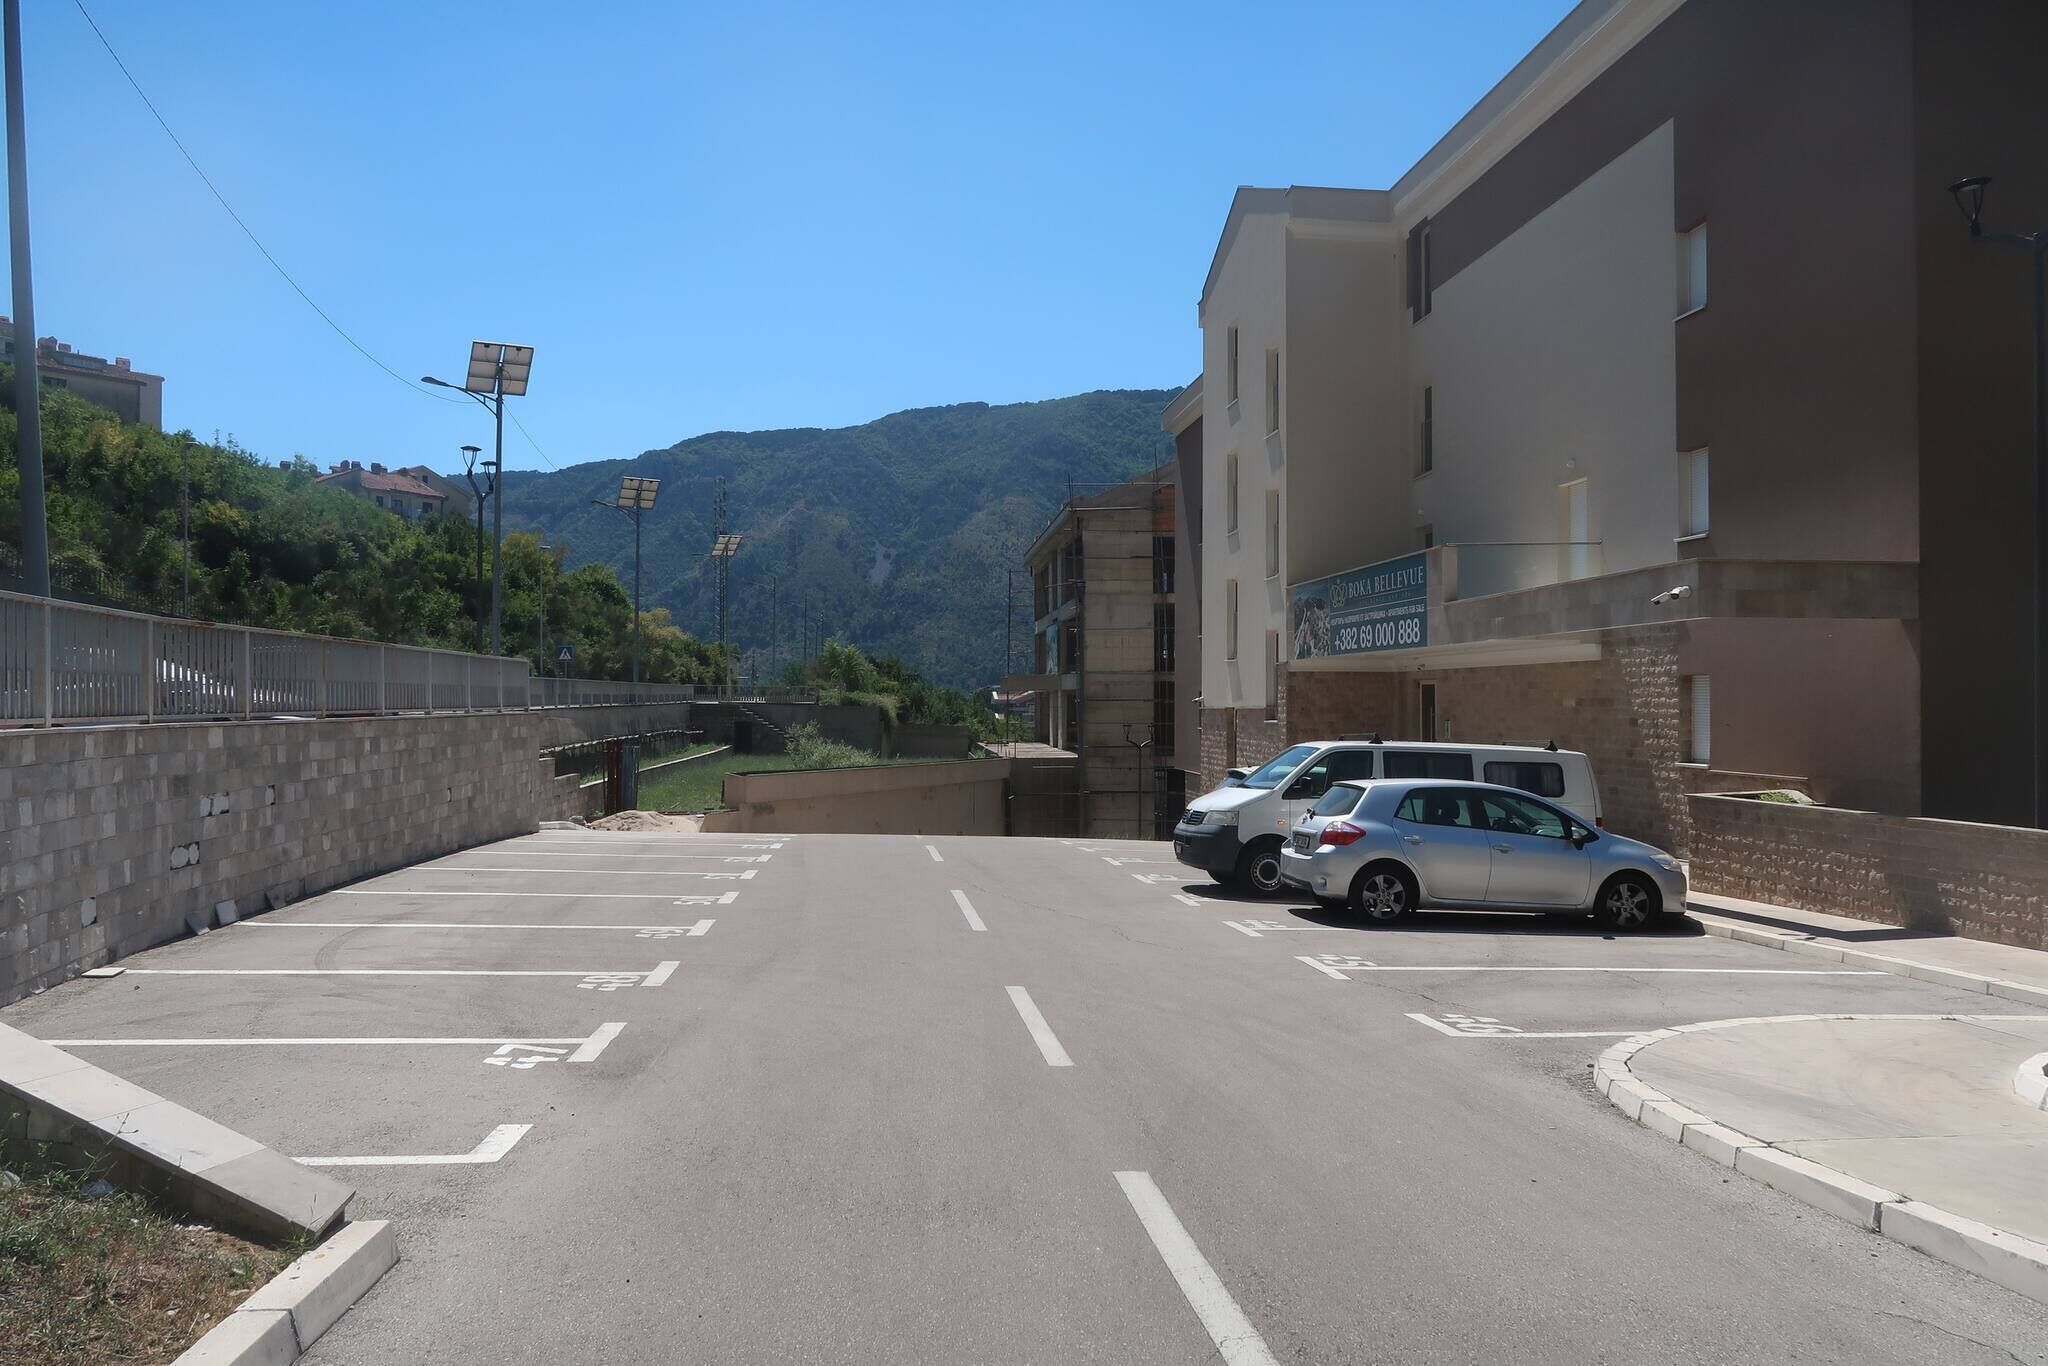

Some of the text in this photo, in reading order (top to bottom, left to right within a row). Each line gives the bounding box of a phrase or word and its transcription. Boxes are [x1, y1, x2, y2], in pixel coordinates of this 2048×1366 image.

[1349, 578, 1372, 598] BOKA
[1374, 566, 1424, 593] BELLEVUE
[1335, 618, 1420, 651] +382 69 000 888
[634, 928, 685, 939] 49
[1315, 953, 1377, 967] 45
[576, 975, 641, 992] 48
[1440, 1013, 1525, 1033] 46
[482, 1043, 569, 1069] 47
